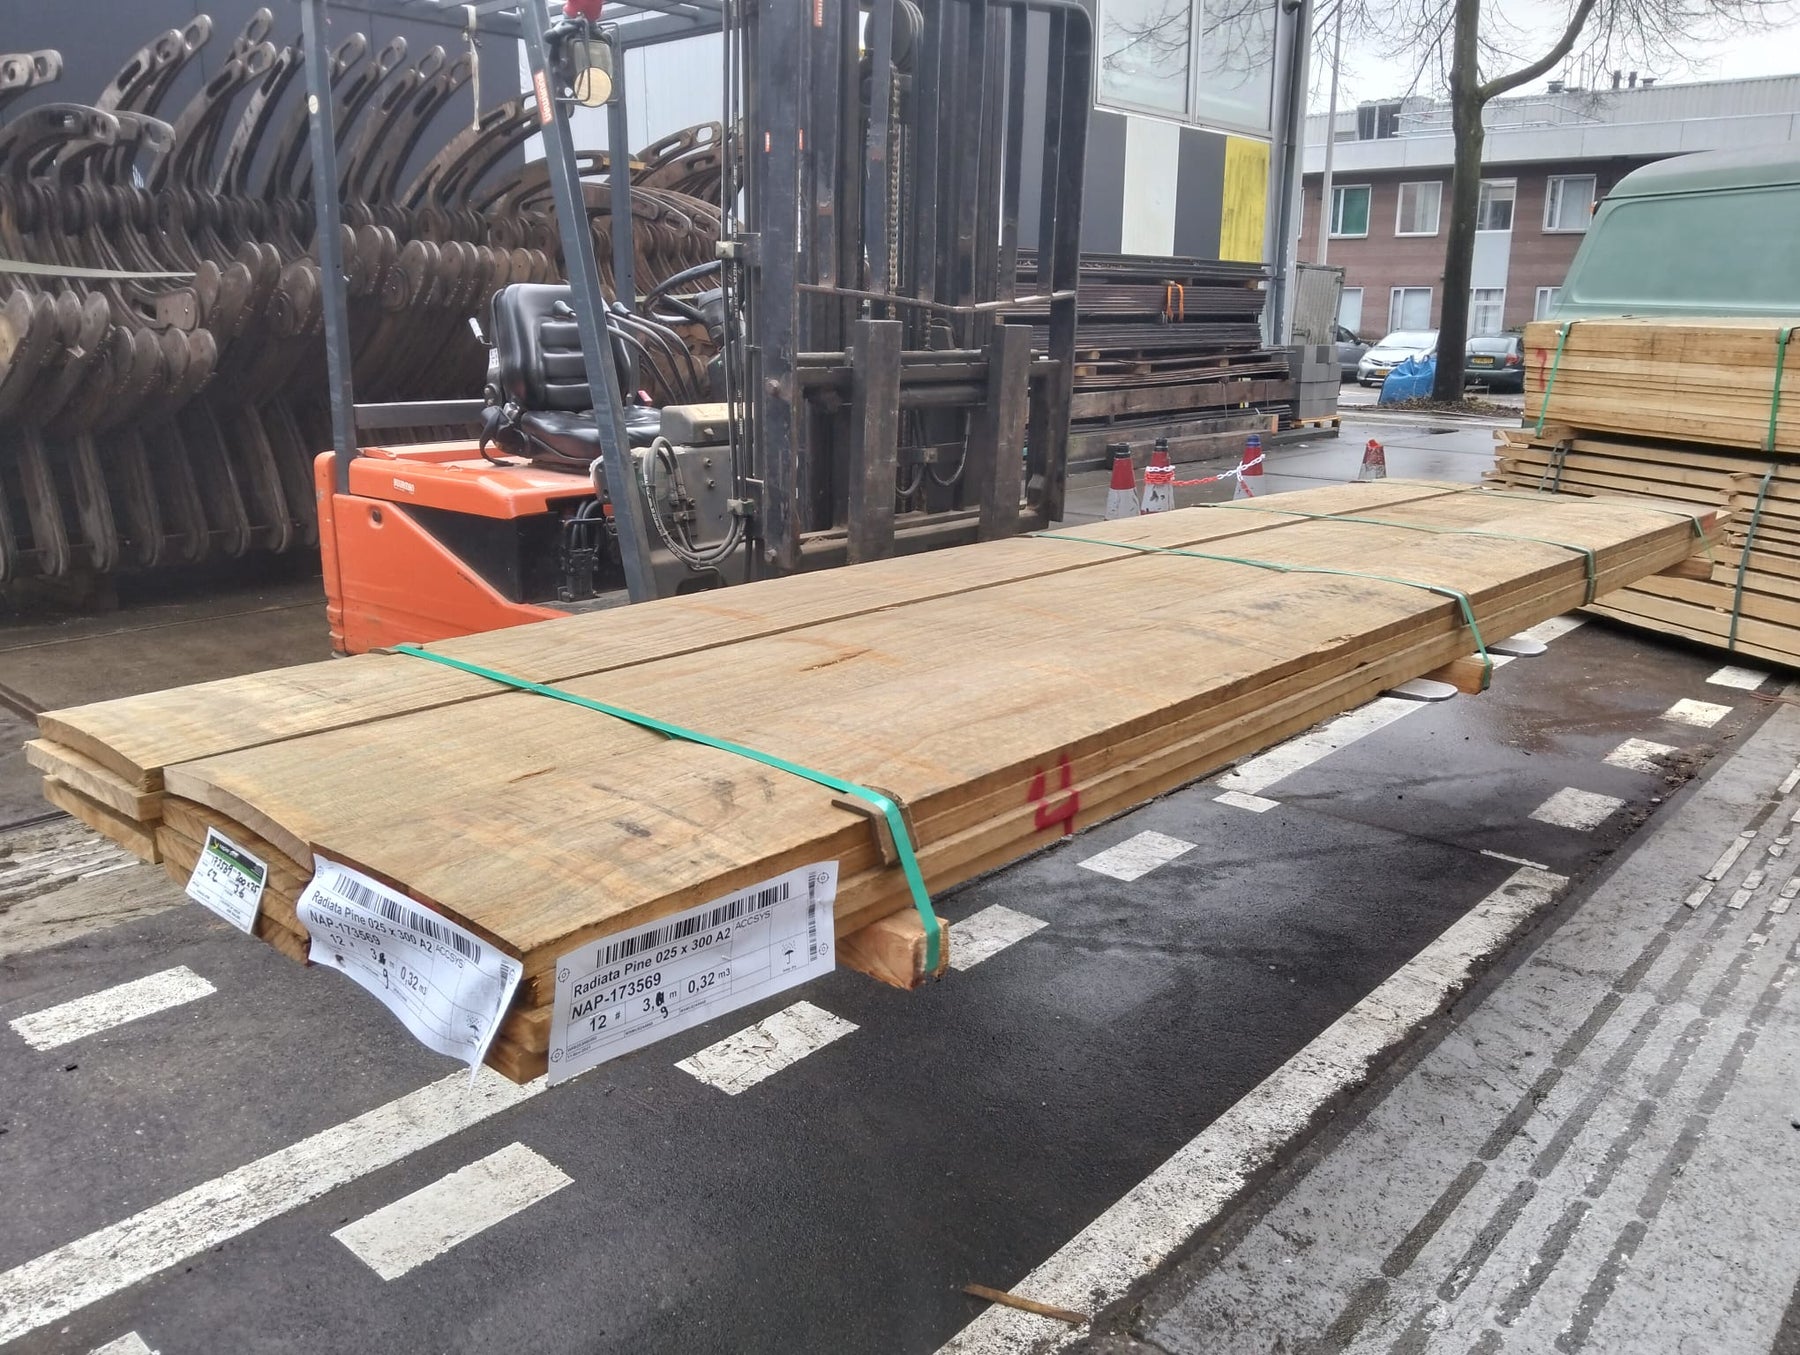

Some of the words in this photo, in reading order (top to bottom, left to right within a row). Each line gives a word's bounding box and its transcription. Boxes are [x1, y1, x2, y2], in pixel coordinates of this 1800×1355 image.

[1027, 753, 1080, 835] 4
[309, 909, 381, 946] NAP-173569
[311, 890, 342, 915] Radiata
[344, 907, 366, 925] Pine
[368, 917, 387, 933] 025
[389, 928, 397, 937] x
[397, 929, 417, 945] 300
[420, 938, 433, 954] A2
[436, 944, 464, 969] ACCSYS
[574, 969, 620, 998] Radiata
[624, 958, 652, 975] Pine
[655, 946, 677, 964] 025
[680, 945, 688, 955] x
[691, 934, 713, 951] 300
[715, 927, 731, 943] A2
[735, 910, 771, 931] ACCSYS
[330, 933, 346, 947] 12
[400, 966, 419, 991] 0,32
[571, 972, 662, 1020] NAP-173569
[589, 1014, 607, 1032] 12
[669, 990, 677, 999] m
[688, 971, 715, 994] 0,32
[718, 967, 731, 979] m3
[660, 1006, 669, 1019] 9
